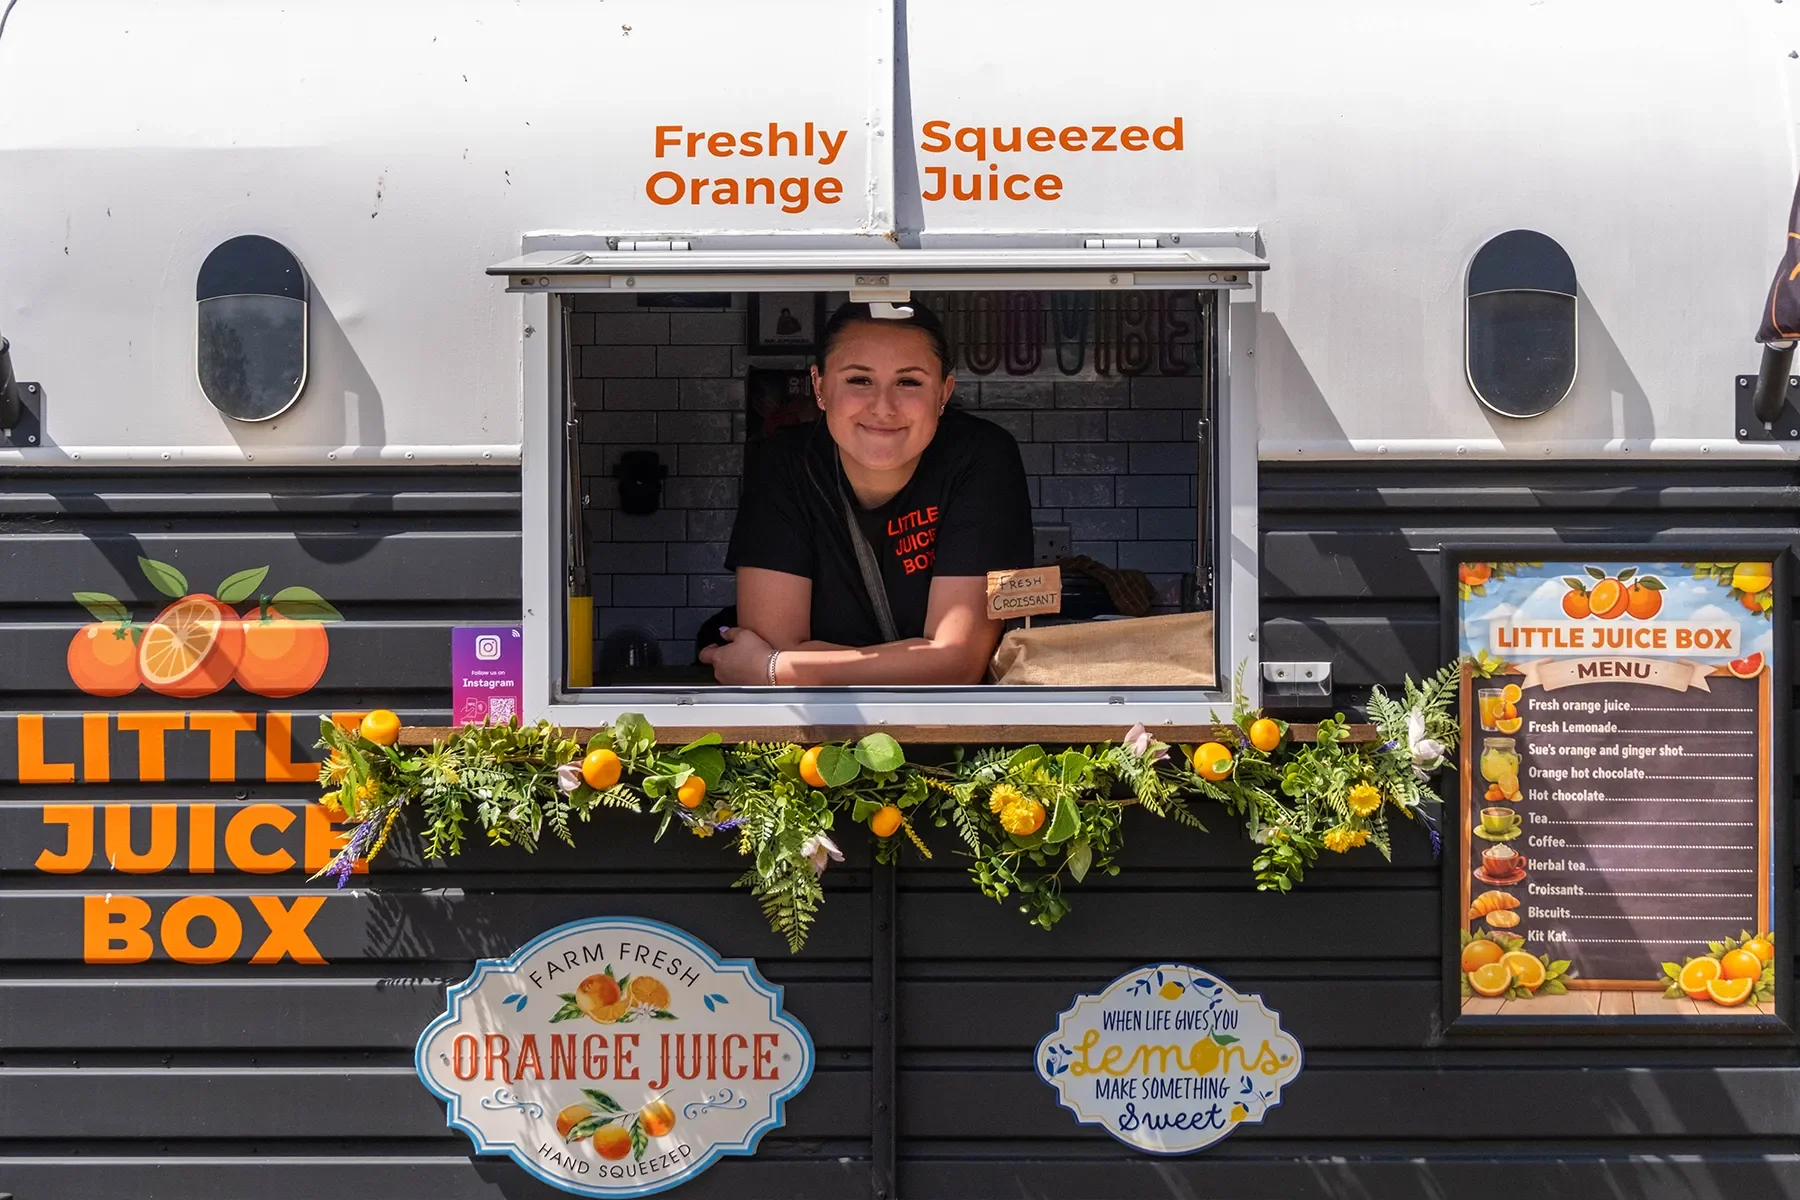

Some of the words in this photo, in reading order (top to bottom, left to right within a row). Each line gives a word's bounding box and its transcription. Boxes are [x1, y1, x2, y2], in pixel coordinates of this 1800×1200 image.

[654, 122, 848, 165] Freshly
[920, 117, 1184, 161] Squeezed
[645, 170, 843, 214] Orange
[921, 163, 1064, 201] Juice
[1051, 290, 1203, 376] VIBE
[887, 505, 939, 537] LITTLE
[999, 574, 1042, 591] FRESH
[992, 593, 1058, 611] CROISSANT
[1498, 627, 1584, 649] LITTLE
[1592, 627, 1666, 649] JUICE
[1676, 628, 1732, 649] BOX
[1577, 661, 1651, 679] MENU
[463, 678, 514, 689] Instagram
[1529, 699, 1560, 711] Fresh
[1562, 701, 1601, 715] orange
[1603, 699, 1630, 715] juice
[1529, 721, 1560, 734] Fresh
[1562, 721, 1618, 734] Lemonade
[1528, 744, 1556, 757] Sue's
[1558, 746, 1597, 760] orange
[1599, 744, 1620, 757] and
[1622, 744, 1657, 760] ginger
[1659, 744, 1683, 757] shot
[1528, 767, 1569, 782] Orange
[1571, 766, 1590, 779] hot
[1592, 766, 1645, 780] chocolate
[1528, 789, 1549, 801] Hot
[1551, 789, 1605, 801] chocolate
[1528, 812, 1548, 824] Tea
[34, 803, 370, 874] JUICE
[1528, 835, 1566, 847] Coffee
[1528, 859, 1565, 871] Herbal
[1568, 860, 1586, 871] tea
[1528, 883, 1584, 896] Croissants
[1528, 906, 1571, 918] Biscuits
[84, 895, 330, 965] BOX
[1528, 930, 1545, 942] Kit
[1547, 930, 1567, 942] Kat
[529, 942, 604, 989] FARM
[619, 942, 700, 989] FRESH
[1103, 1009, 1142, 1031] WHEN
[1145, 1010, 1171, 1030] LIFE
[1175, 1010, 1209, 1030] GIVES
[1212, 1009, 1239, 1030] YOU
[451, 1033, 640, 1085] ORANGE
[648, 1033, 780, 1090] JUICE
[1095, 1078, 1138, 1100] MAKE
[1142, 1077, 1231, 1100] SOMETHING
[1118, 1102, 1227, 1131] Sweet
[538, 1142, 590, 1175] HAND
[599, 1143, 692, 1179] SQUEEZED
